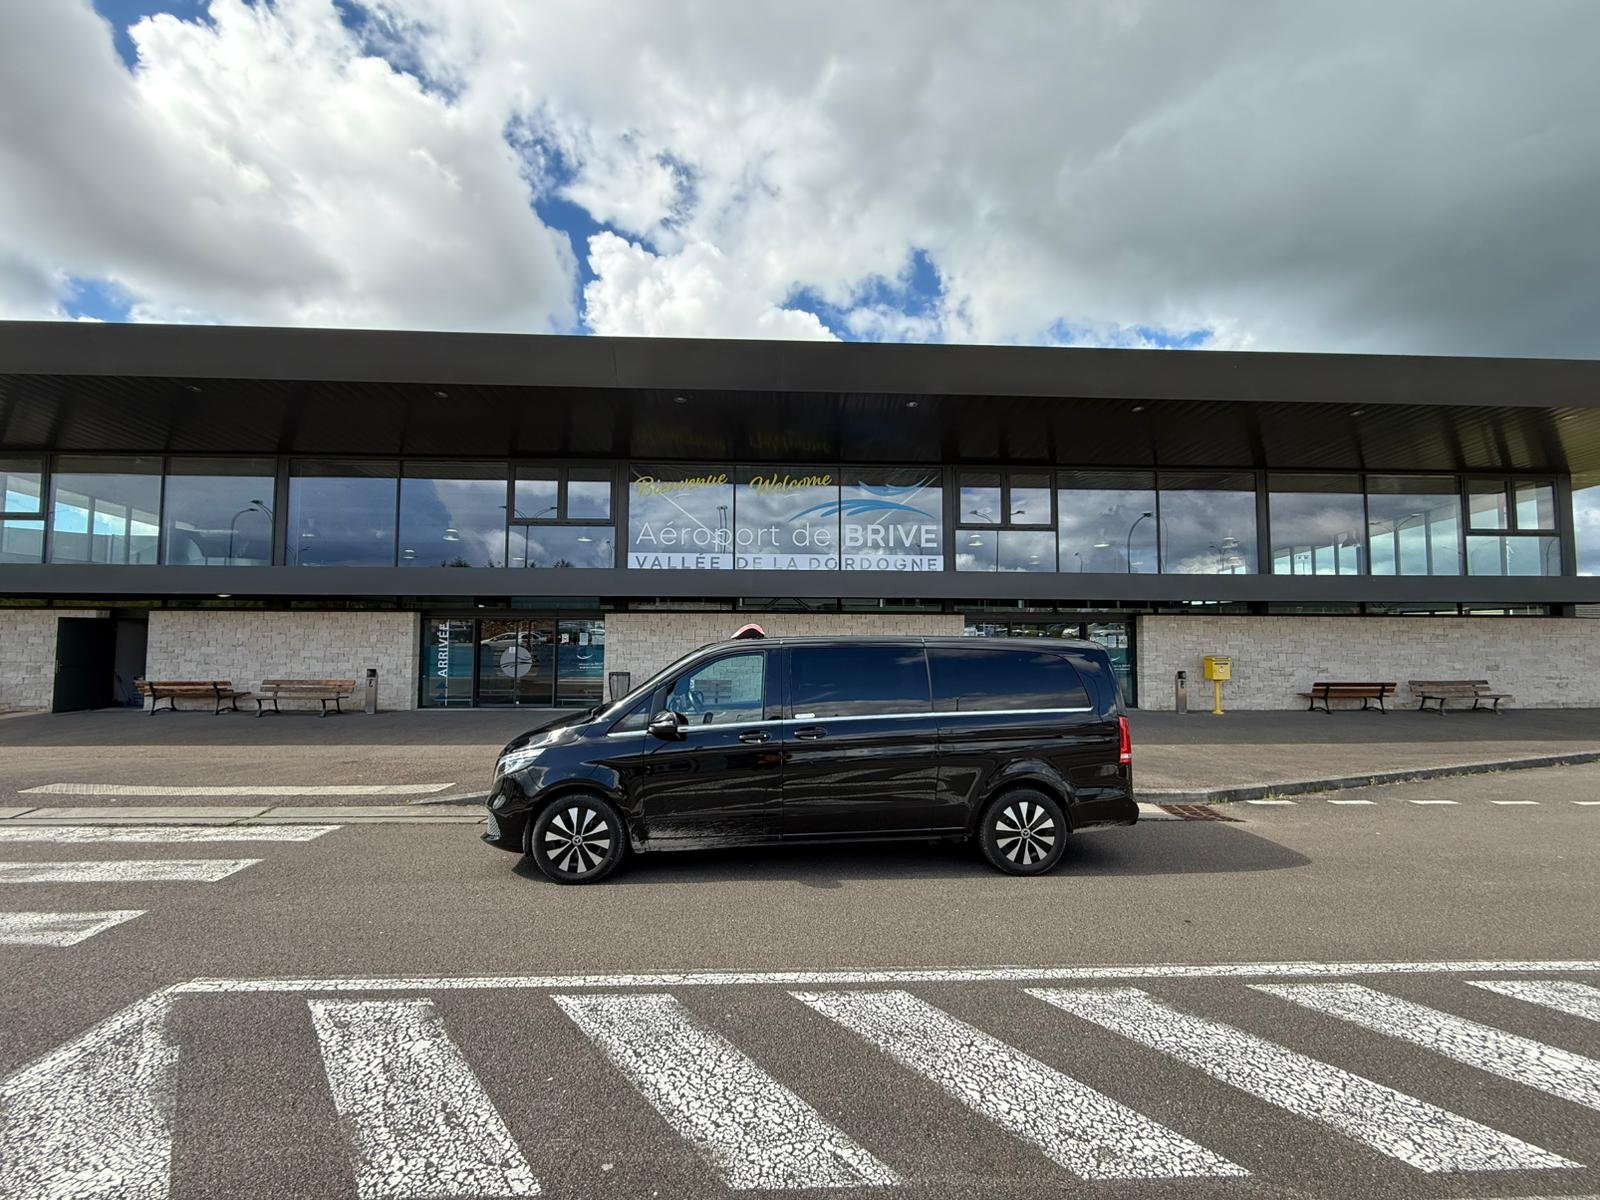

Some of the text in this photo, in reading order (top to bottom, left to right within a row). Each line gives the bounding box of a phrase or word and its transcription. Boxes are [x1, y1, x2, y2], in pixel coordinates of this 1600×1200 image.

[634, 473, 832, 496] Bienvenue Welcome
[636, 521, 938, 552] Aéroport de BRIVE
[635, 553, 938, 570] VALLÉE DE LA DORDOGNE
[437, 623, 448, 678] ARRIVÉE
